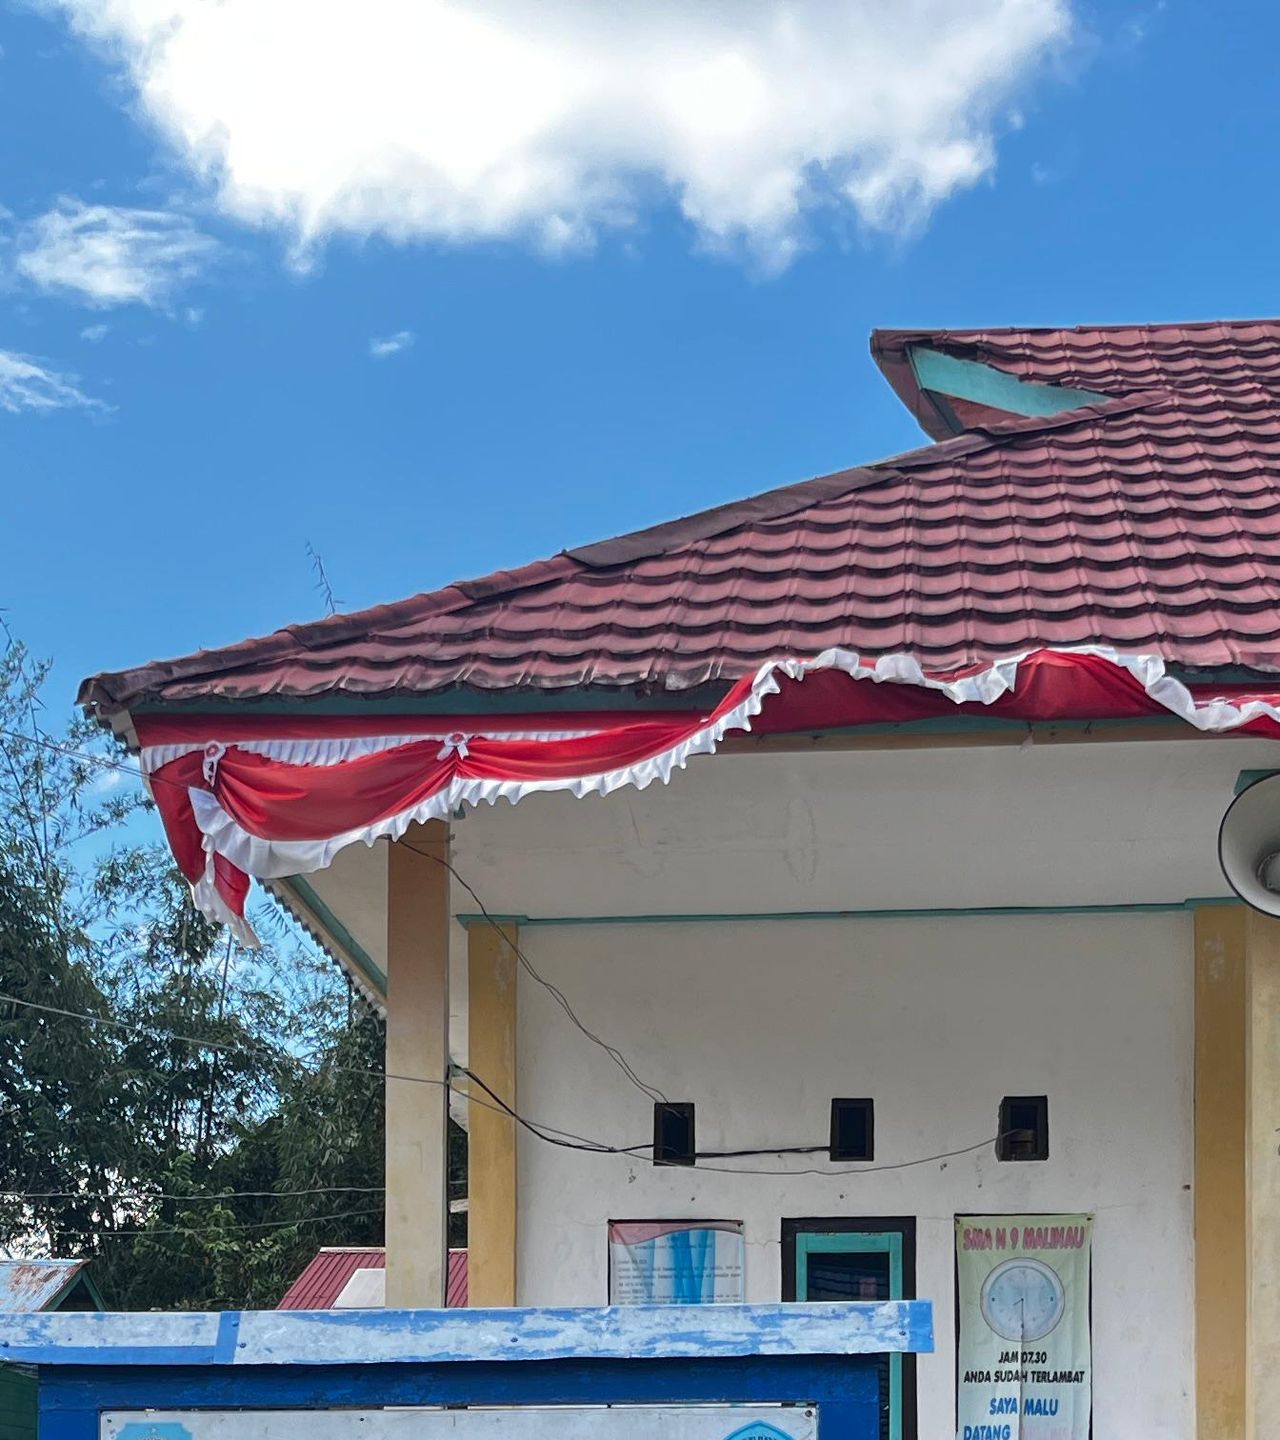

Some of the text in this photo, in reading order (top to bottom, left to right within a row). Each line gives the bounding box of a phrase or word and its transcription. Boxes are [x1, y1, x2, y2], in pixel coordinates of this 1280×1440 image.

[963, 1226, 1085, 1250] SMA N 9 MALINAU
[999, 1351, 1019, 1363] JAM
[964, 1370, 1085, 1383] ANDA SUDAH TERLAMBAT
[989, 1398, 1059, 1416] SAYA MALU
